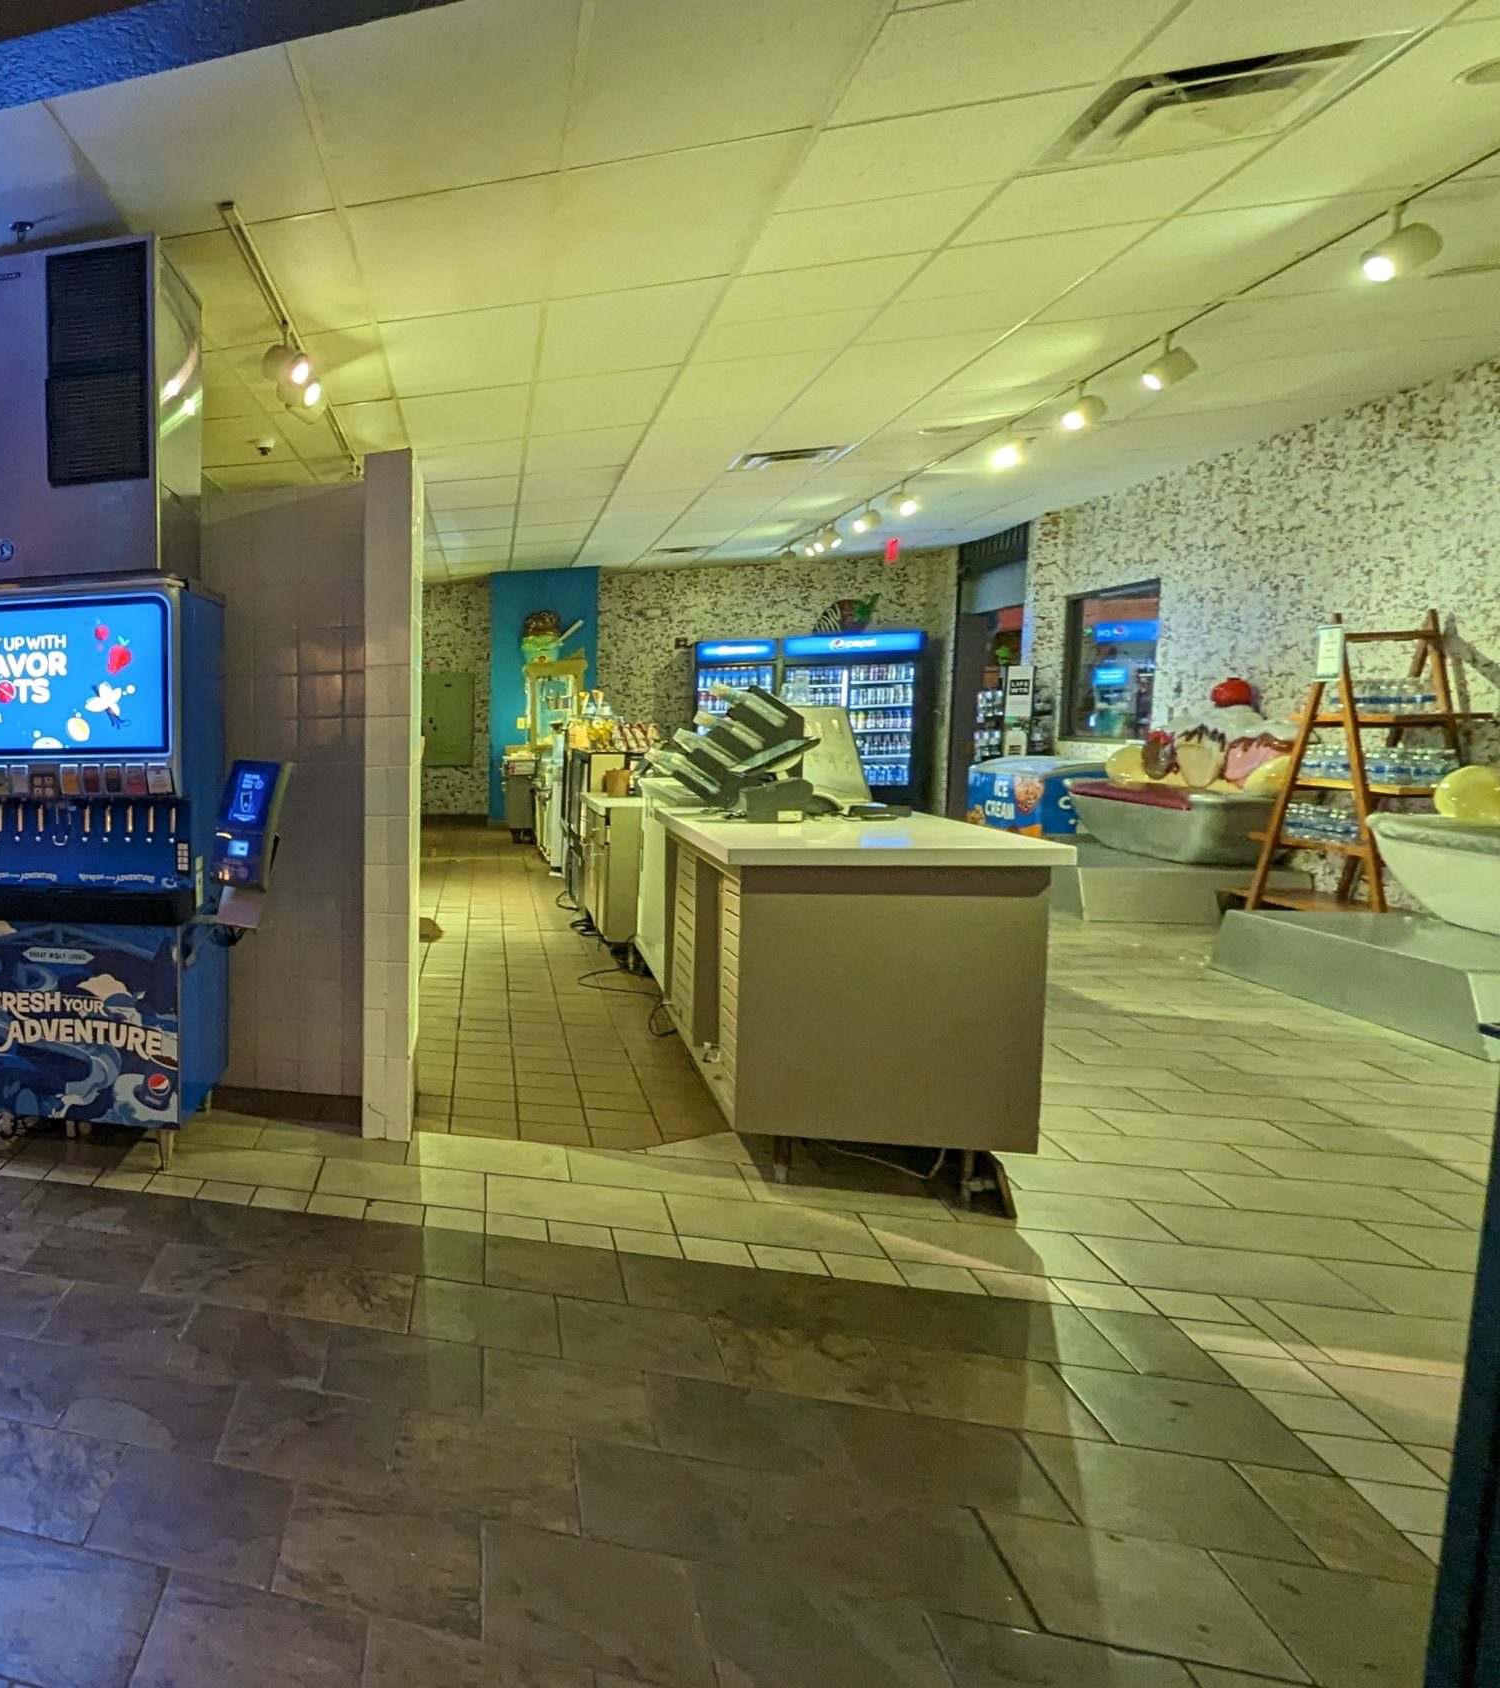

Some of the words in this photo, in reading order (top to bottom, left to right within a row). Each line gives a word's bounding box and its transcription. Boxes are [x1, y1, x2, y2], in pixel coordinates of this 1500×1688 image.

[4, 636, 25, 651] UP
[26, 634, 67, 650] WITH
[993, 780, 1009, 798] ICE
[985, 799, 1015, 820] CREAM
[63, 998, 109, 1018] YOUR
